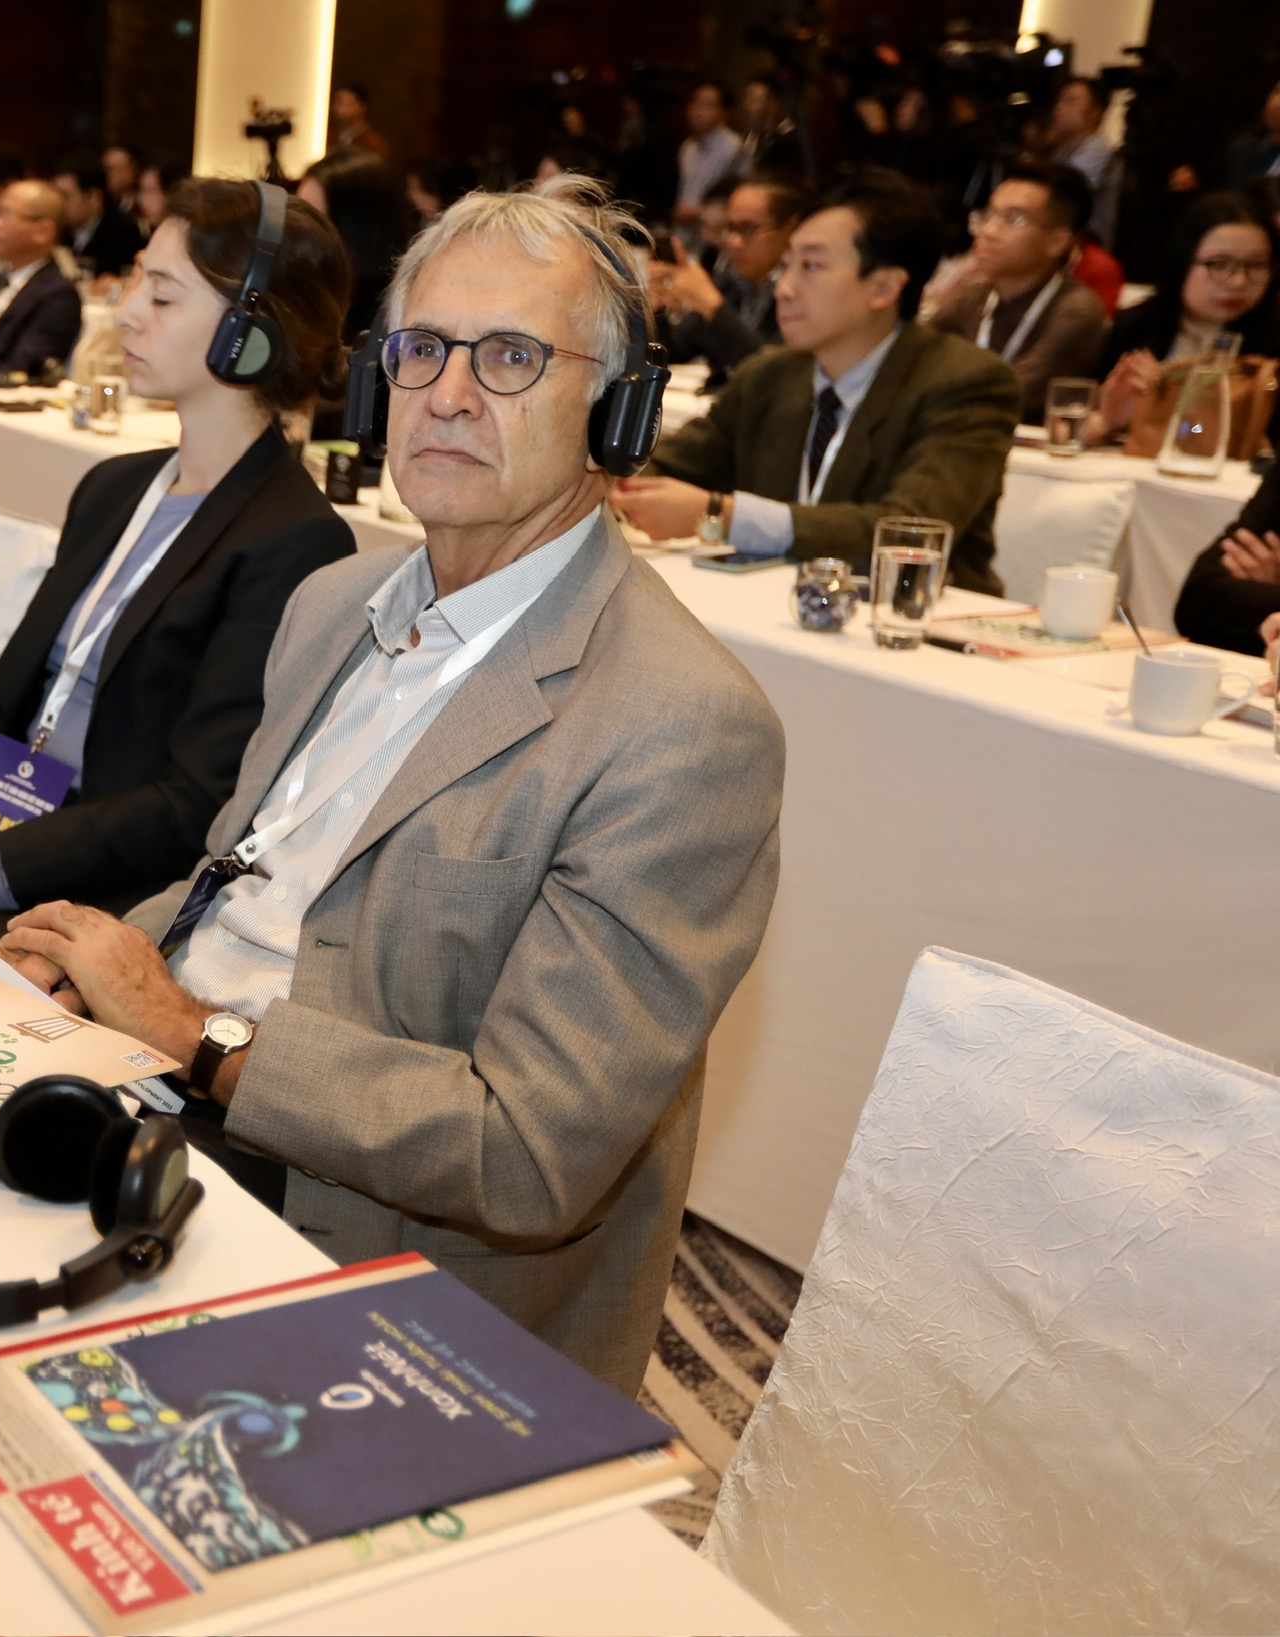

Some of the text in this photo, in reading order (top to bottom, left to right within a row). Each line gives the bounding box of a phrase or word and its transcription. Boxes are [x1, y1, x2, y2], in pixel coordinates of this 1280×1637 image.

[229, 337, 244, 358] VEGA
[134, 1080, 163, 1103] EVELOPMENT
[70, 1521, 155, 1606] Kinh
